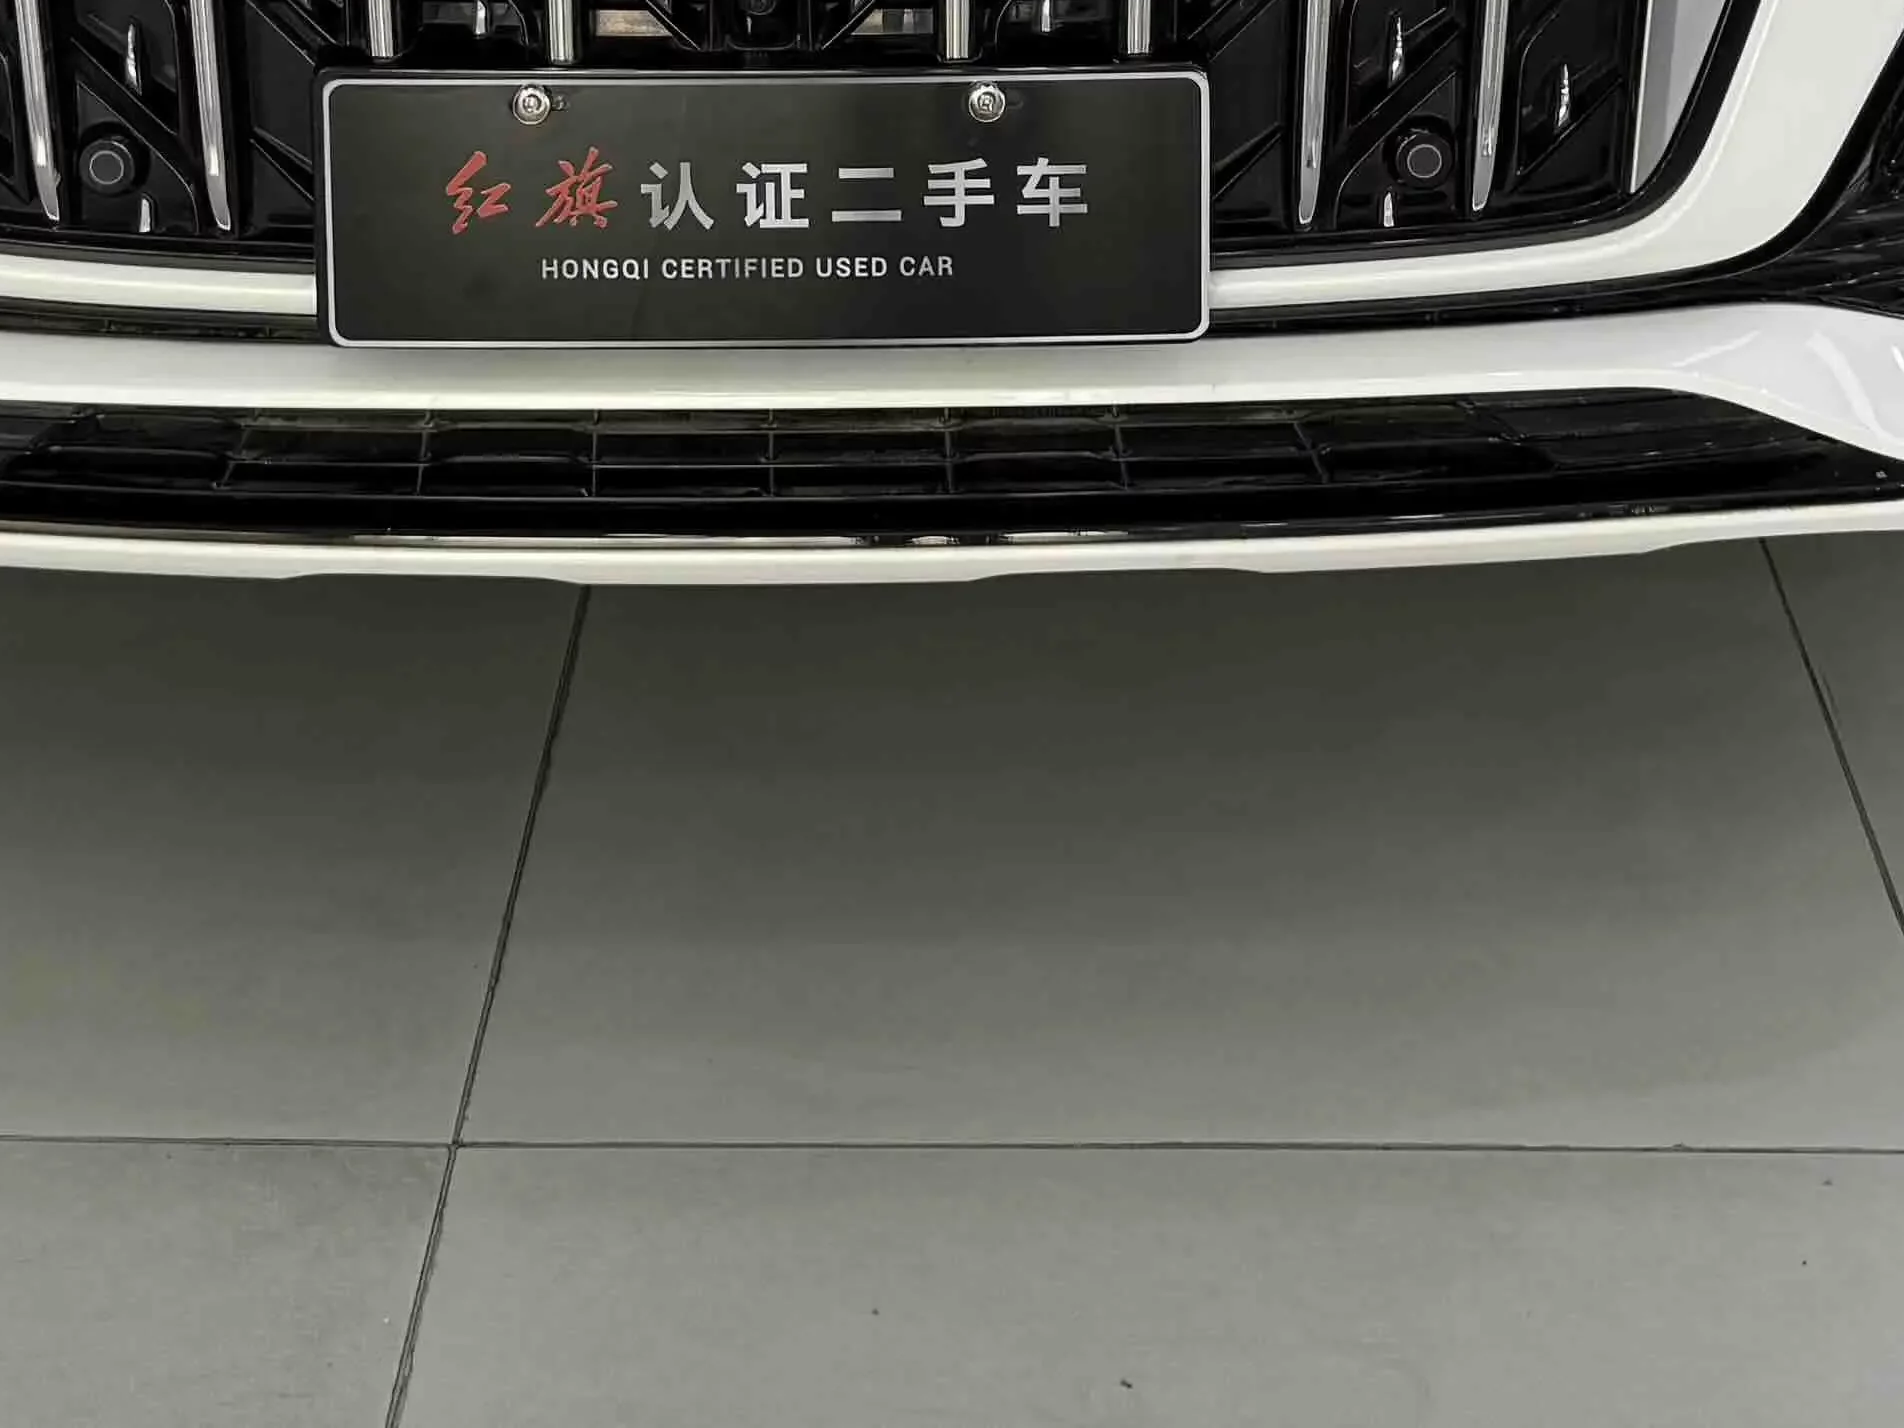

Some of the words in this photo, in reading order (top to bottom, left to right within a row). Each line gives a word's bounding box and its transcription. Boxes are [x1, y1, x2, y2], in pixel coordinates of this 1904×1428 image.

[445, 146, 1089, 234] 红旗认证二手车
[541, 258, 651, 281] HONGQI
[662, 257, 804, 280] CERTIFIED
[816, 256, 888, 278] USED
[899, 255, 954, 277] CAR
